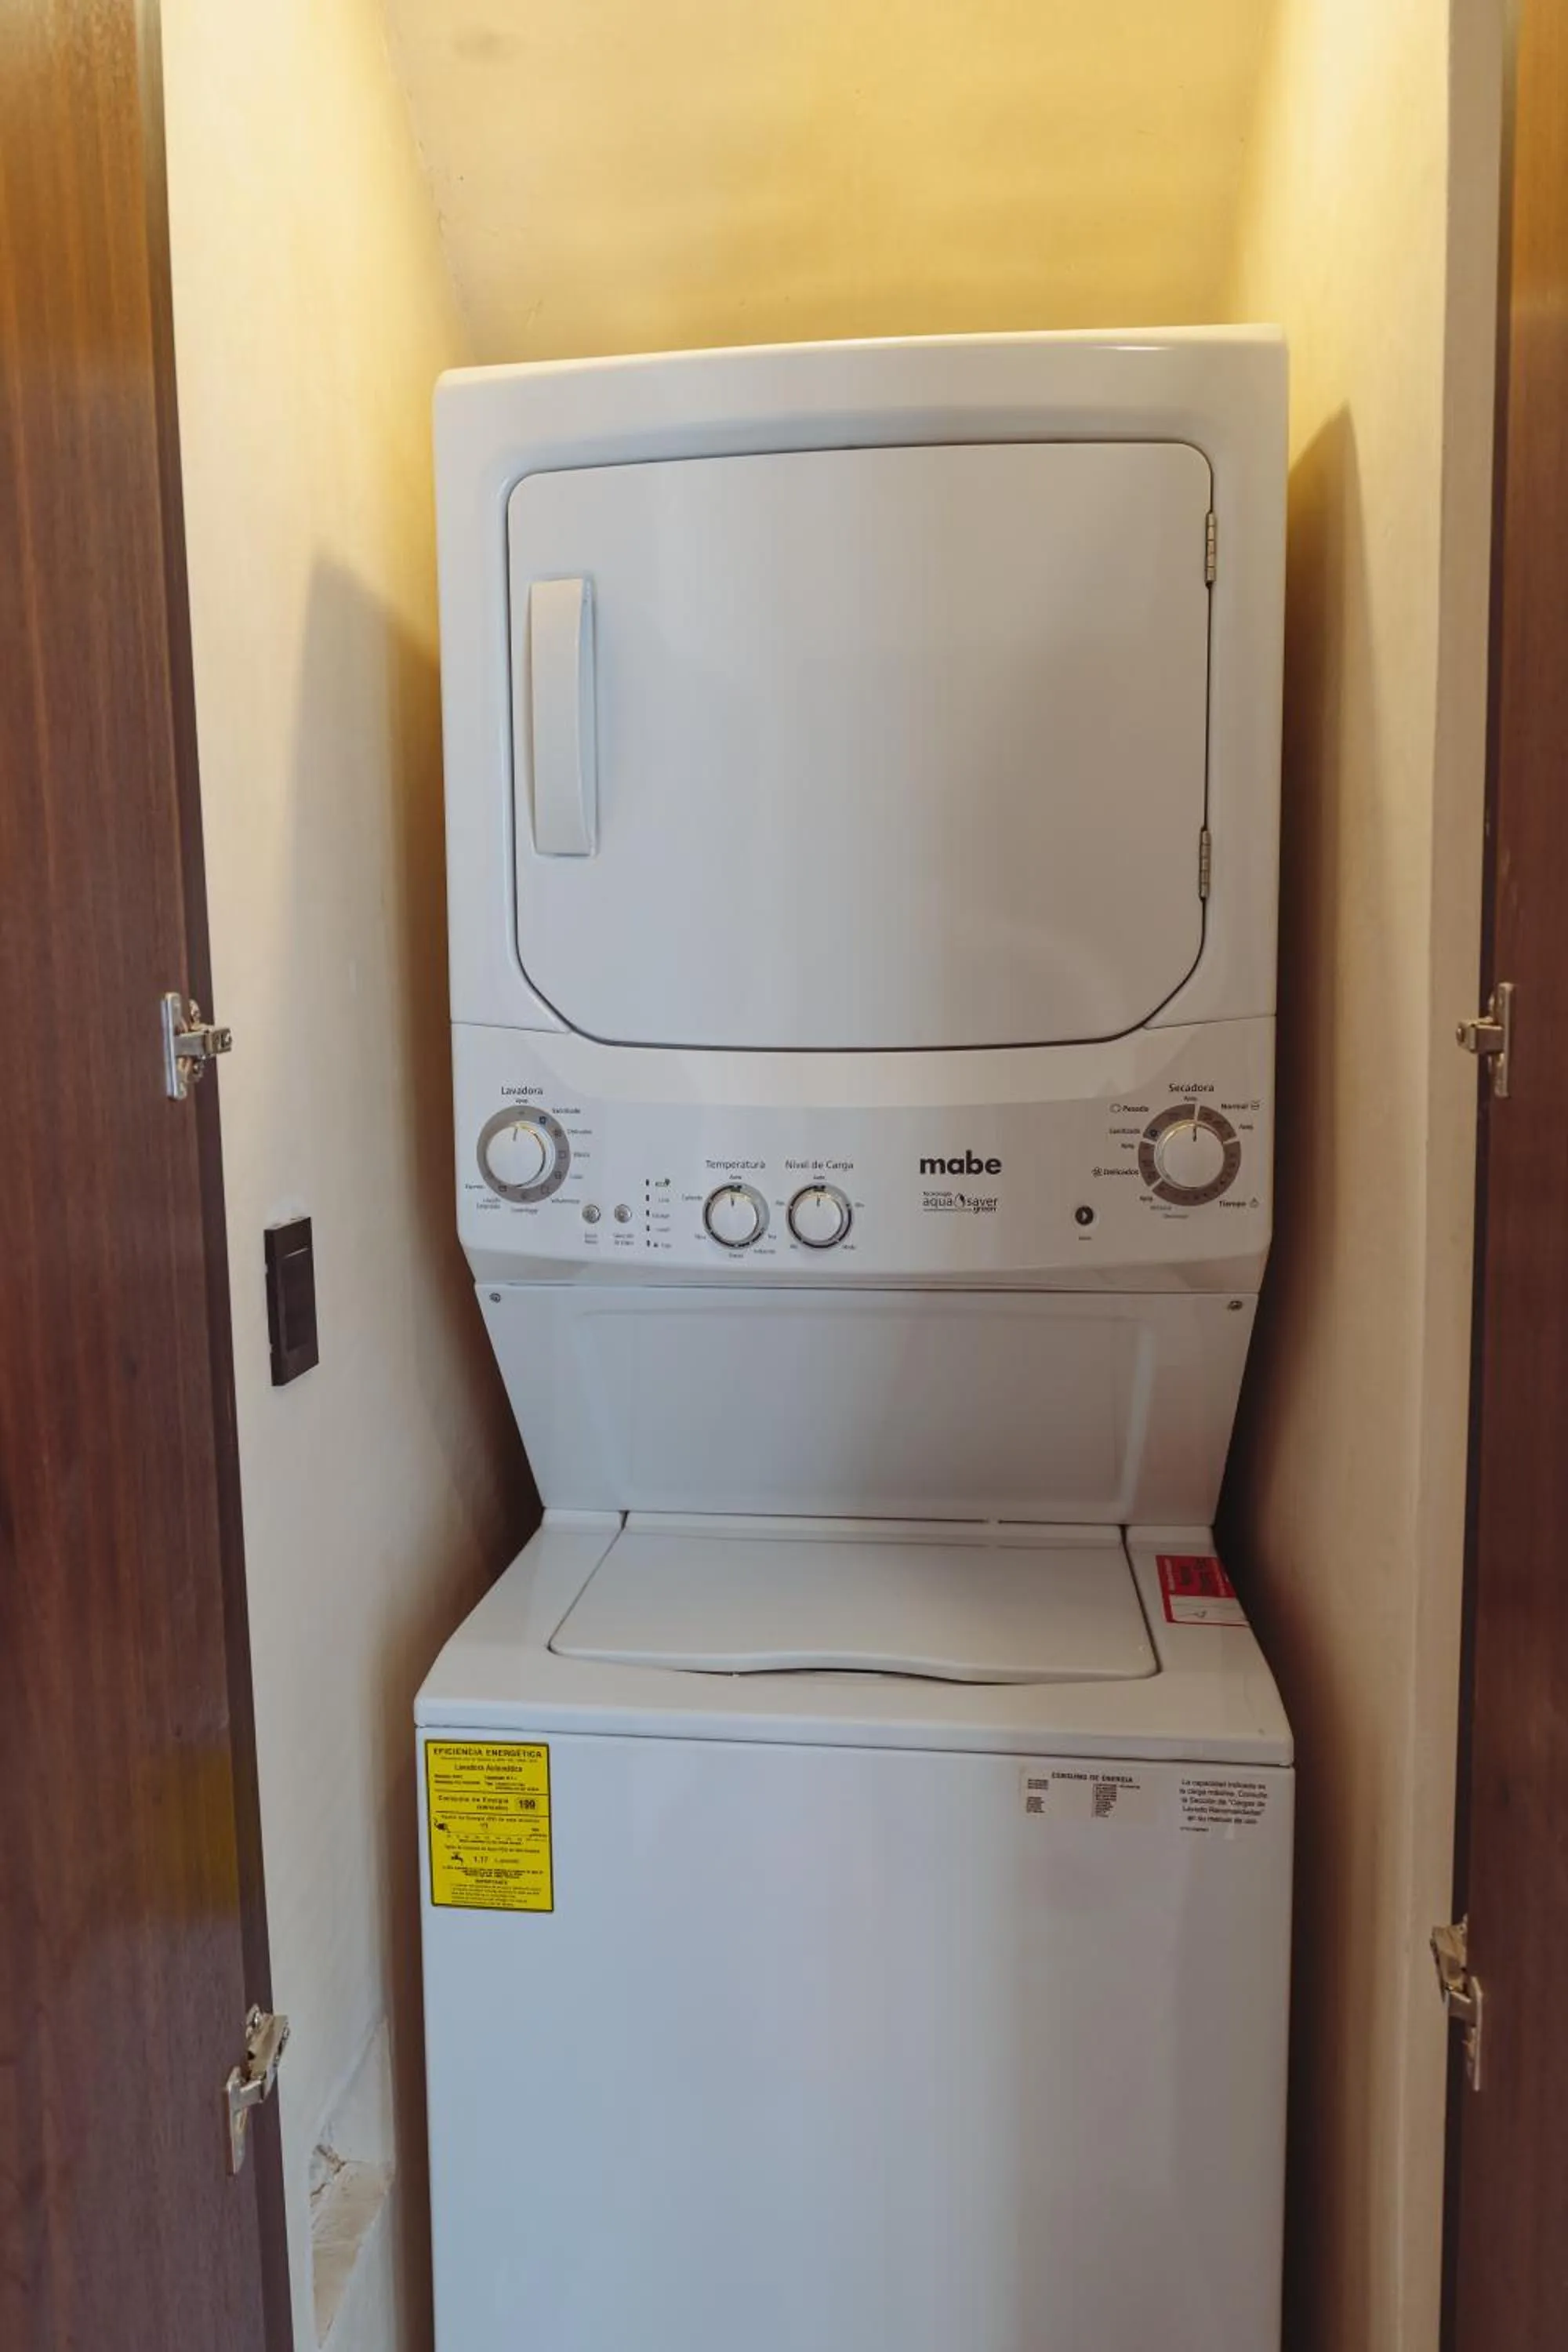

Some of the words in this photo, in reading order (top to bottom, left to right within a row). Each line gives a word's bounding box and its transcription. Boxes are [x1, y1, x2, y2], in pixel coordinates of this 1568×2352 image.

[501, 1086, 543, 1095] Lavadora
[1168, 1083, 1214, 1092] Secadora
[706, 1160, 766, 1170] Temperatura
[785, 1160, 810, 1169] Nivel
[811, 1160, 824, 1169] de
[826, 1160, 854, 1171] Carga
[920, 1149, 1002, 1175] mabe
[923, 1197, 953, 1209] aqua
[966, 1197, 997, 1207] saver
[1218, 1200, 1247, 1209] Tiempo
